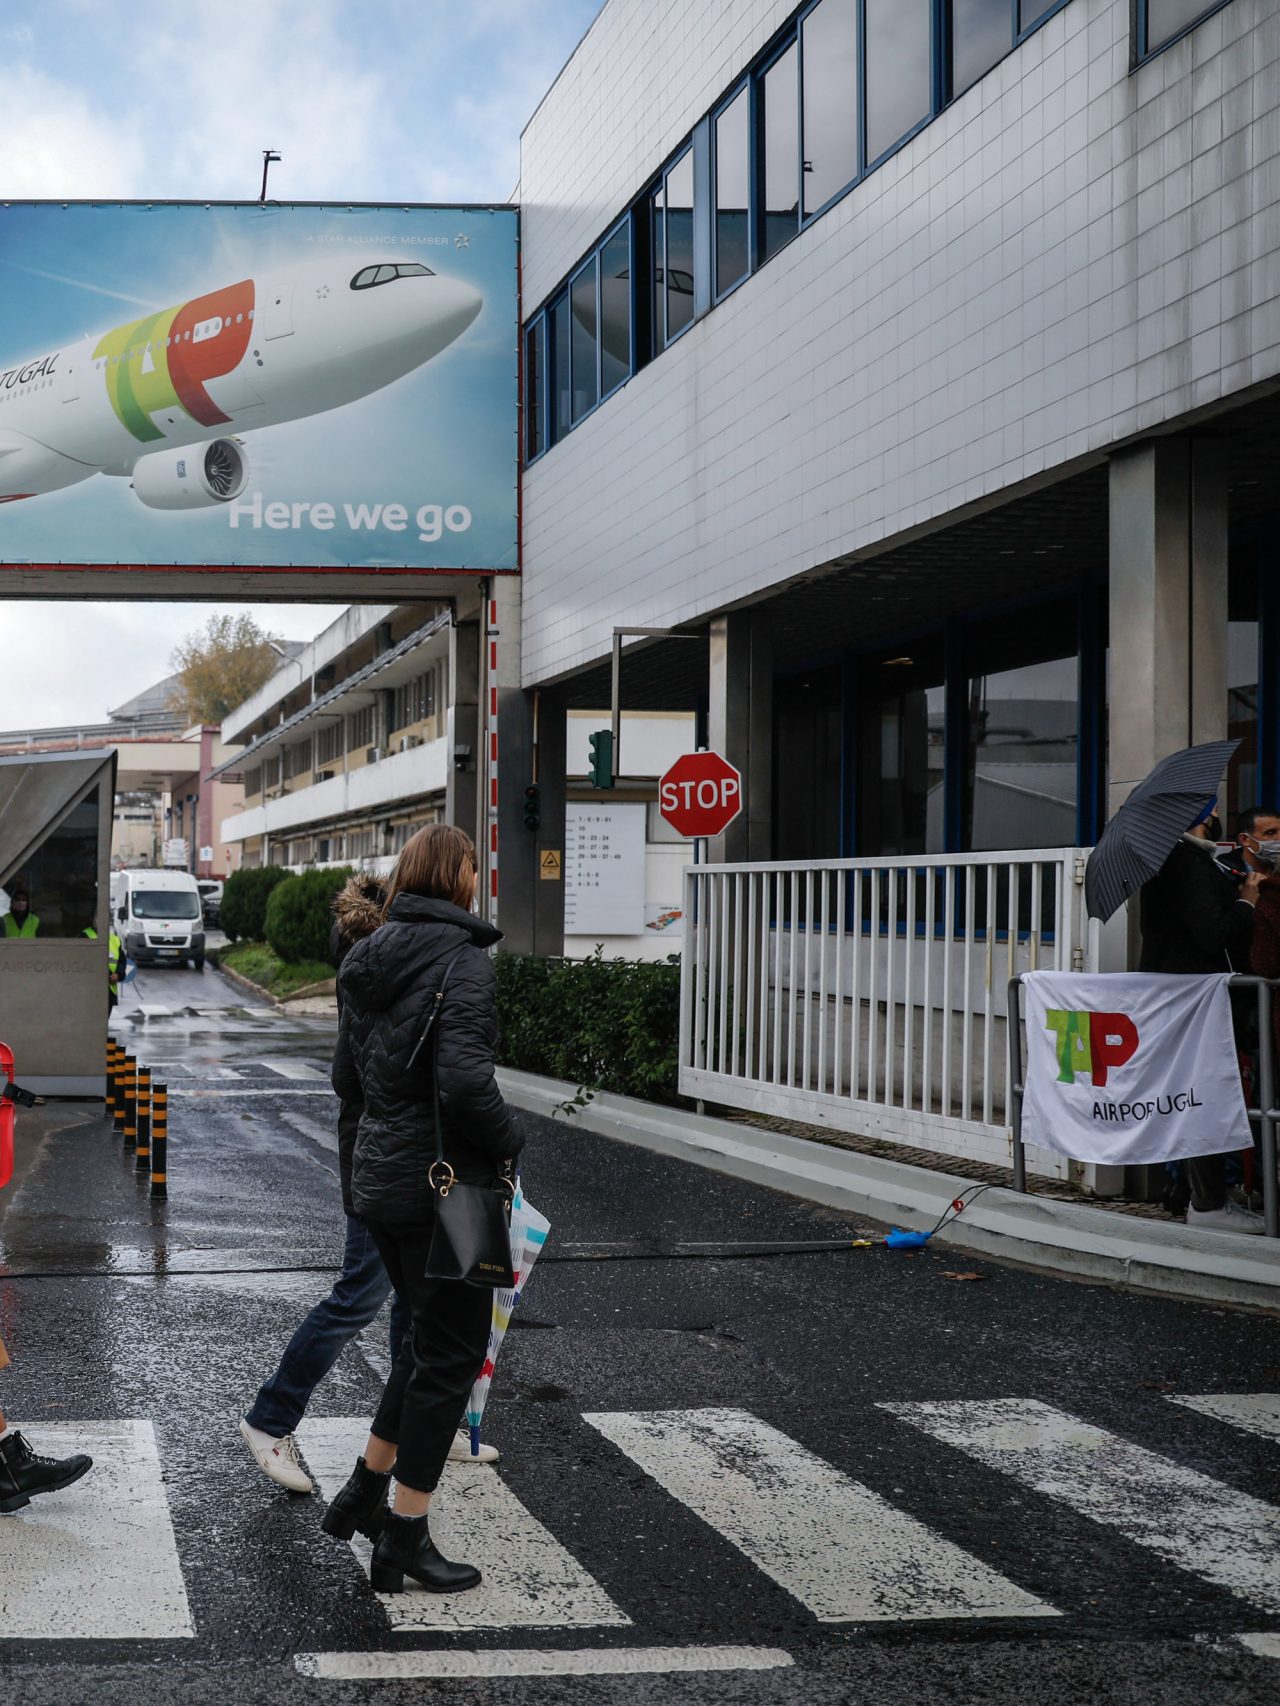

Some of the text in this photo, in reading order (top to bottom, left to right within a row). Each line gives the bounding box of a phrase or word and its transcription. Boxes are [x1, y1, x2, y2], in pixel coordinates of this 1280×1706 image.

[400, 236, 449, 246] MEMBER
[91, 278, 255, 443] TAP
[228, 492, 472, 542] Here we go
[661, 778, 738, 811] STOP
[1045, 1009, 1140, 1087] TAP
